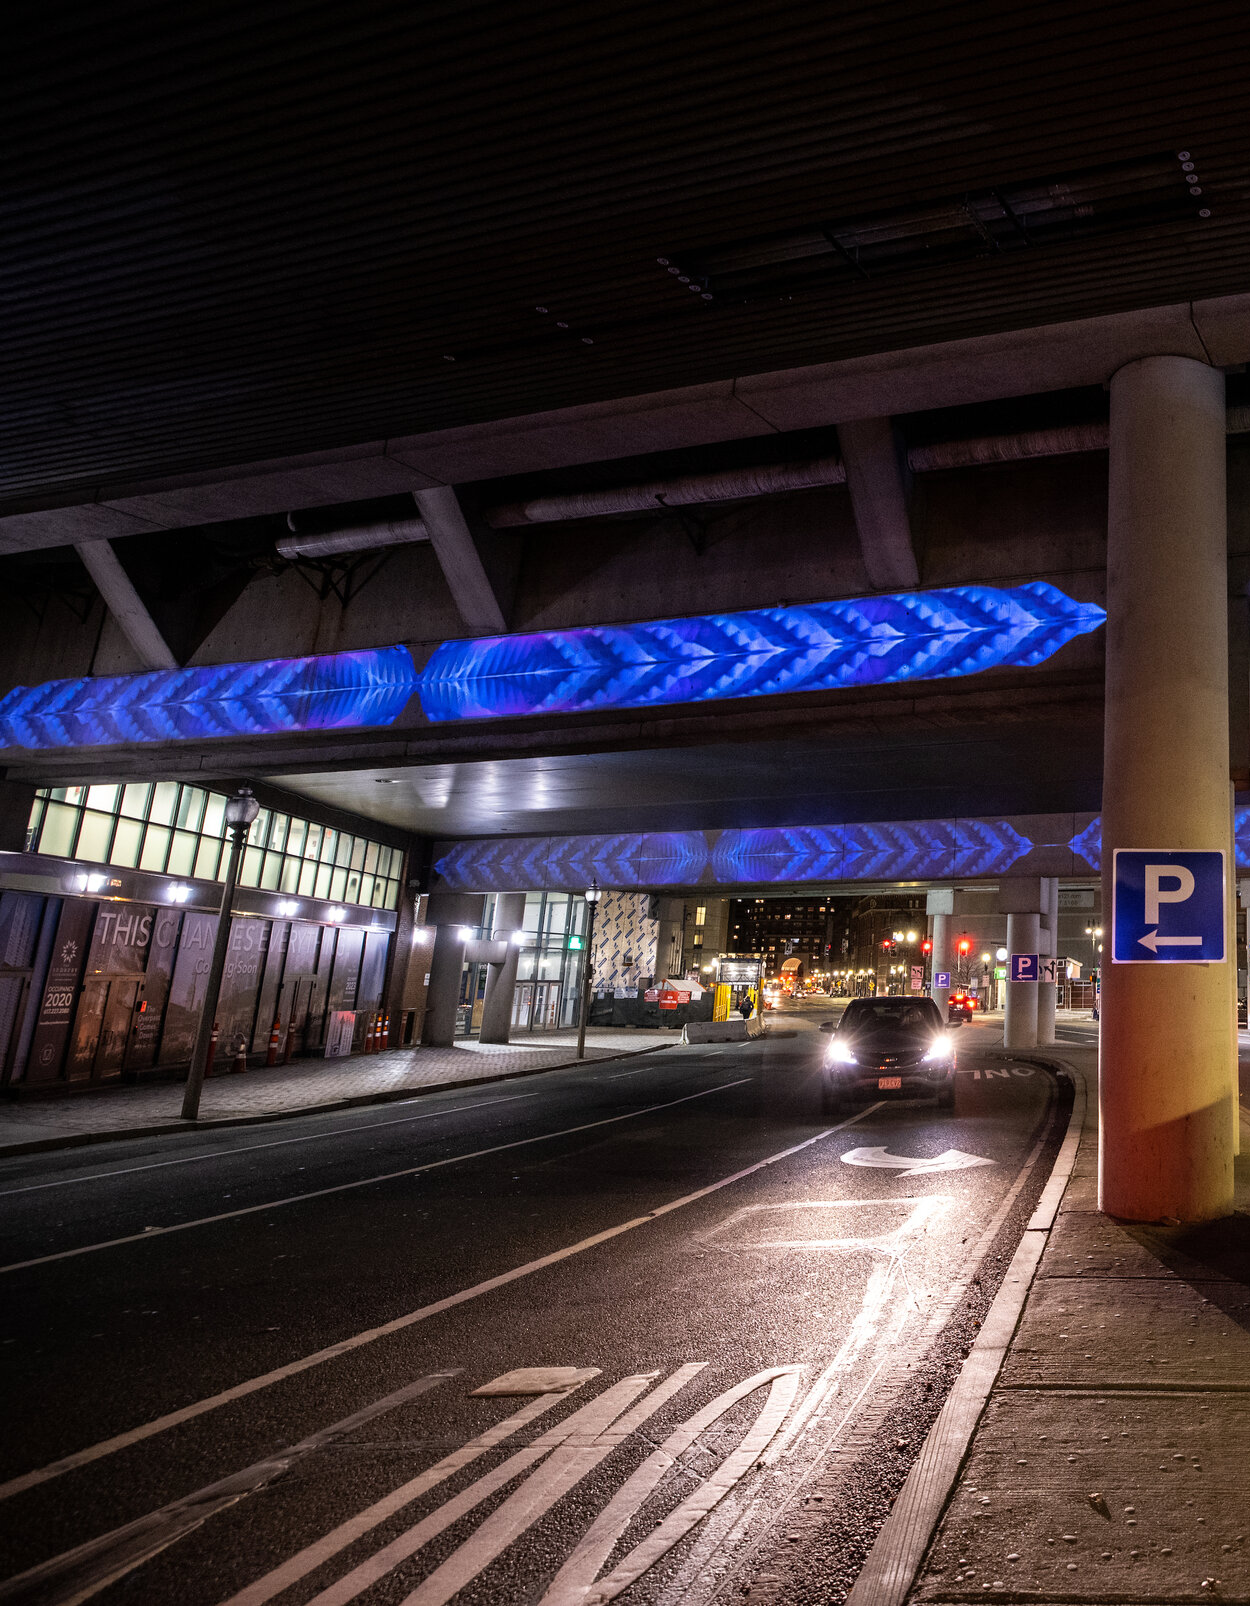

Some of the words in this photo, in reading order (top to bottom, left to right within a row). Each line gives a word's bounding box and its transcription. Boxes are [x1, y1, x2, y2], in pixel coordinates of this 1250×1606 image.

[1144, 864, 1196, 925] P
[100, 912, 153, 947] THIS
[156, 918, 256, 952] CHANES
[236, 960, 258, 974] Soon
[1018, 957, 1032, 973] P
[938, 974, 947, 983] P
[48, 985, 75, 993] OCCUPANCY
[45, 993, 73, 1007] 2020
